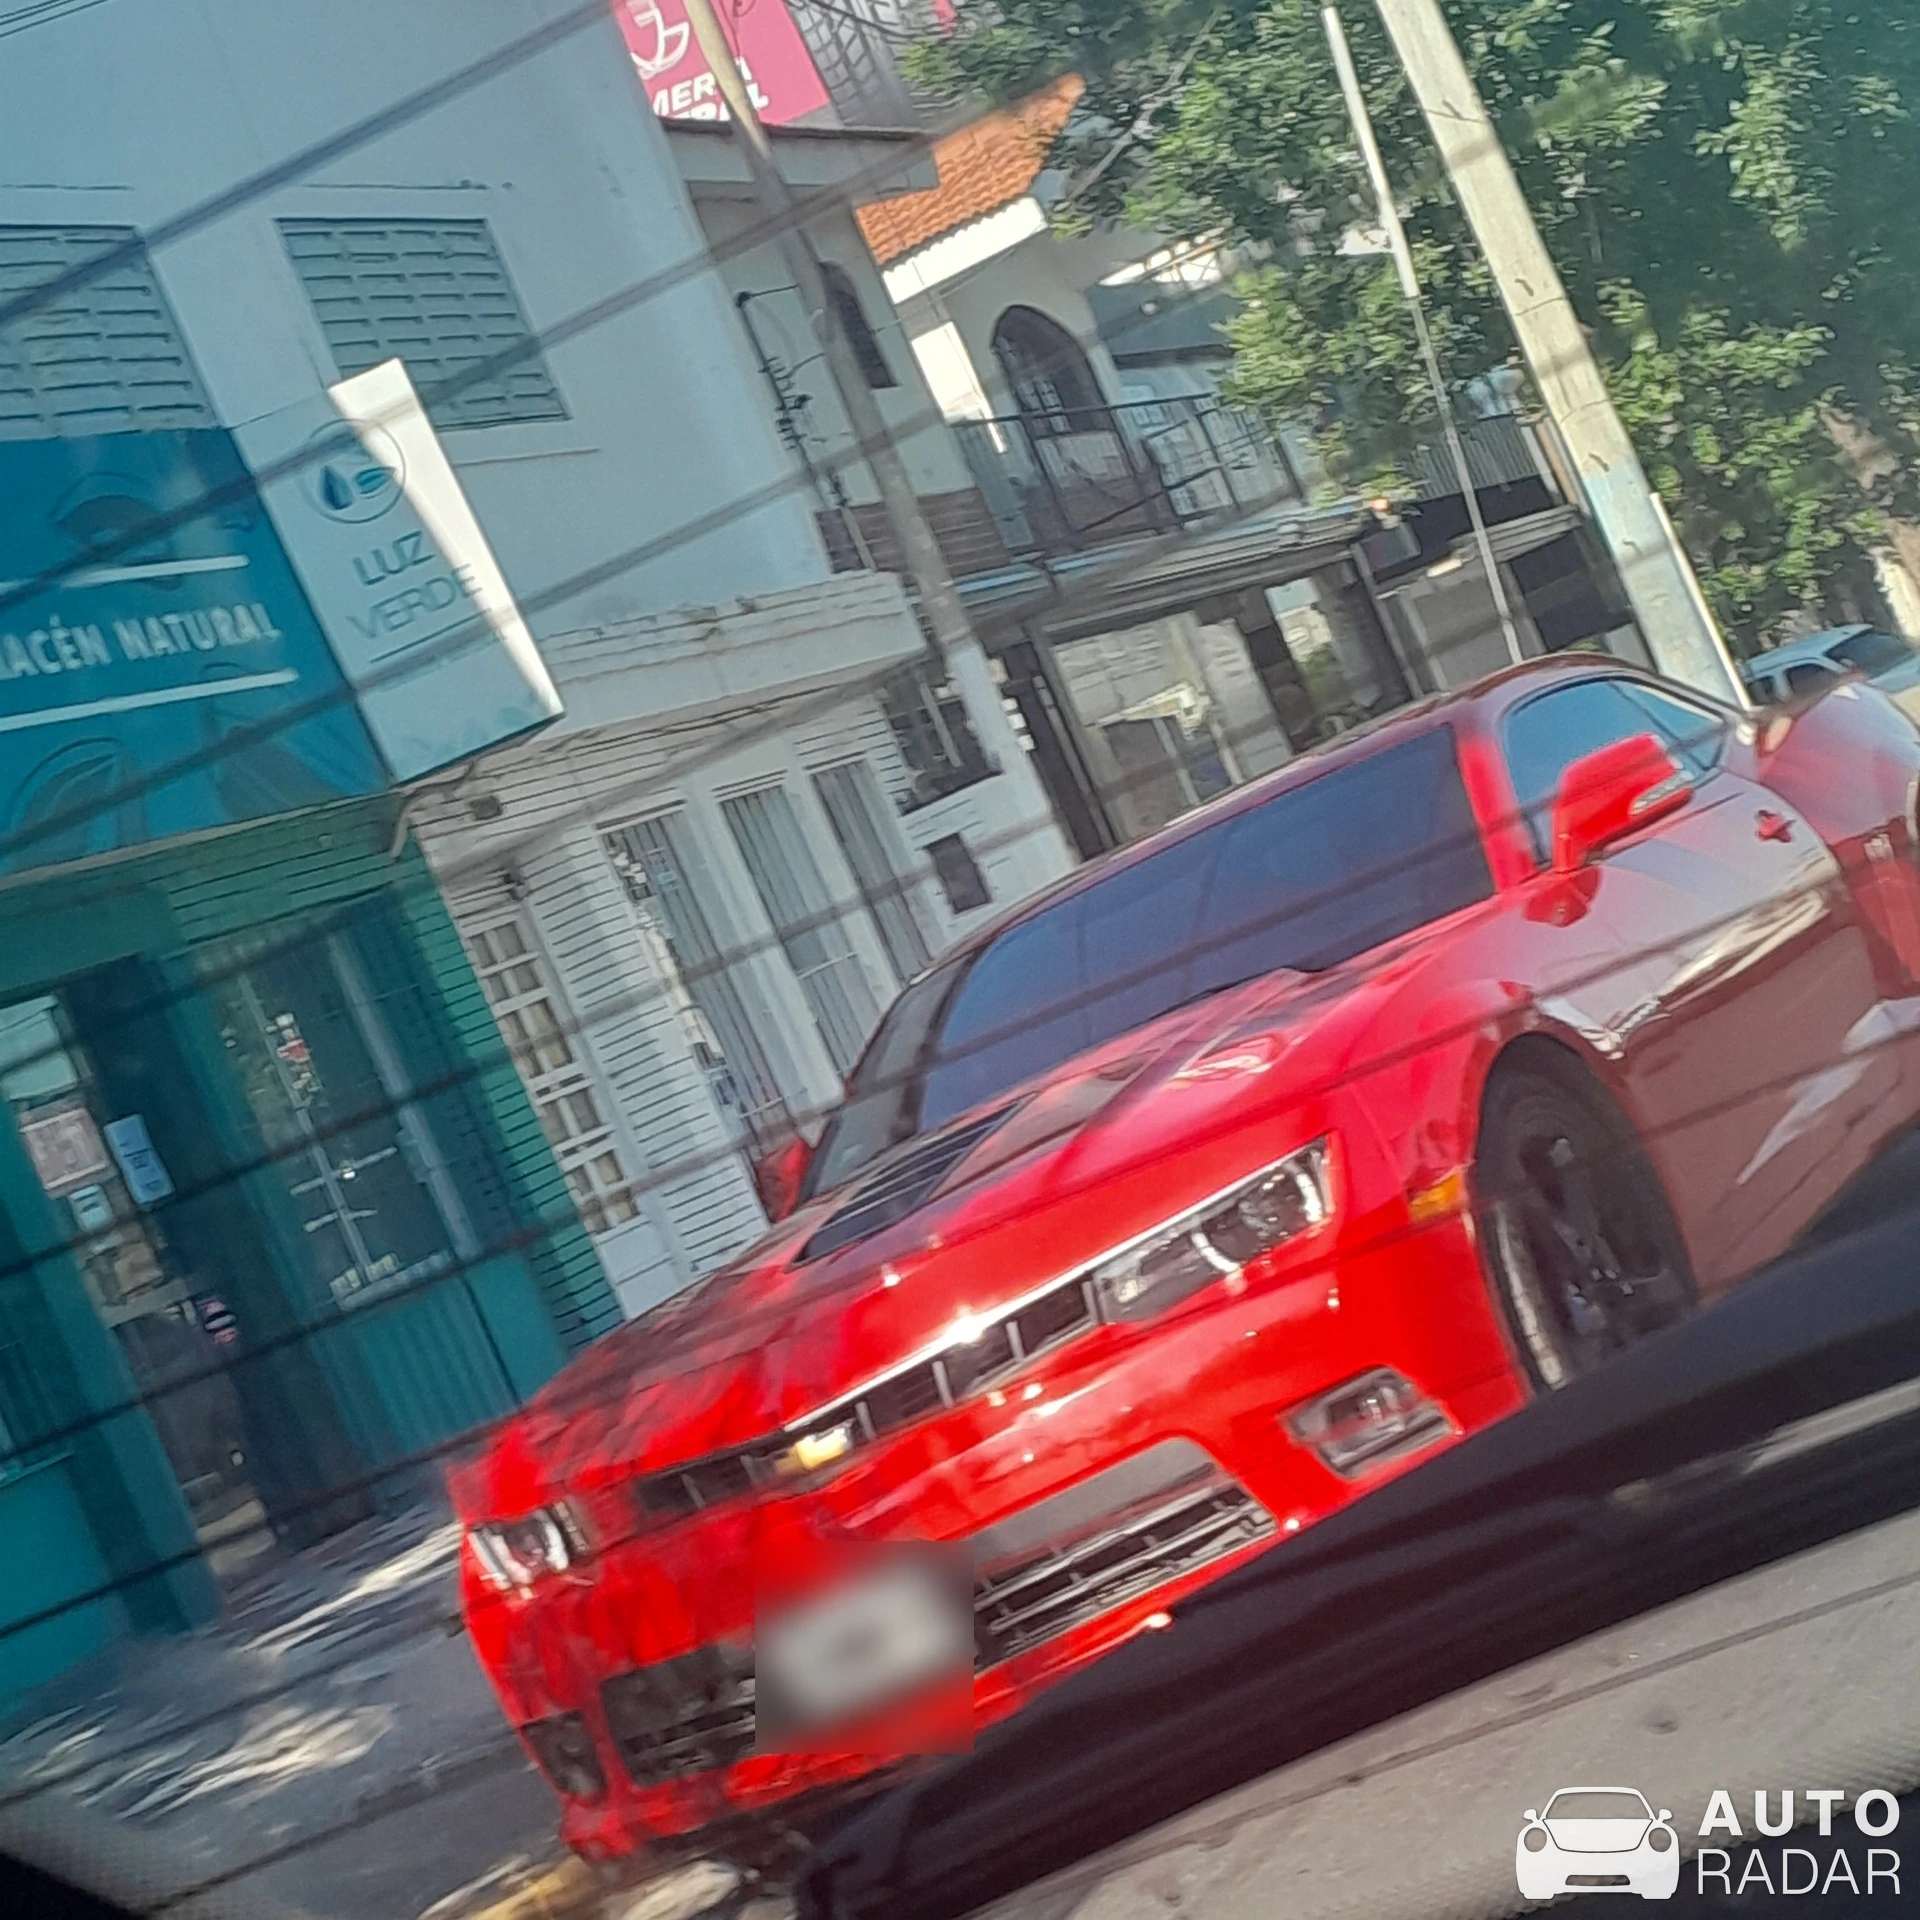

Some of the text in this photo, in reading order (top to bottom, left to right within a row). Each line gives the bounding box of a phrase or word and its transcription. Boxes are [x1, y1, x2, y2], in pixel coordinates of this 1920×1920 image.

[352, 530, 436, 586] LUZ
[346, 563, 482, 639] VERDE
[112, 603, 282, 661] NATURAL
